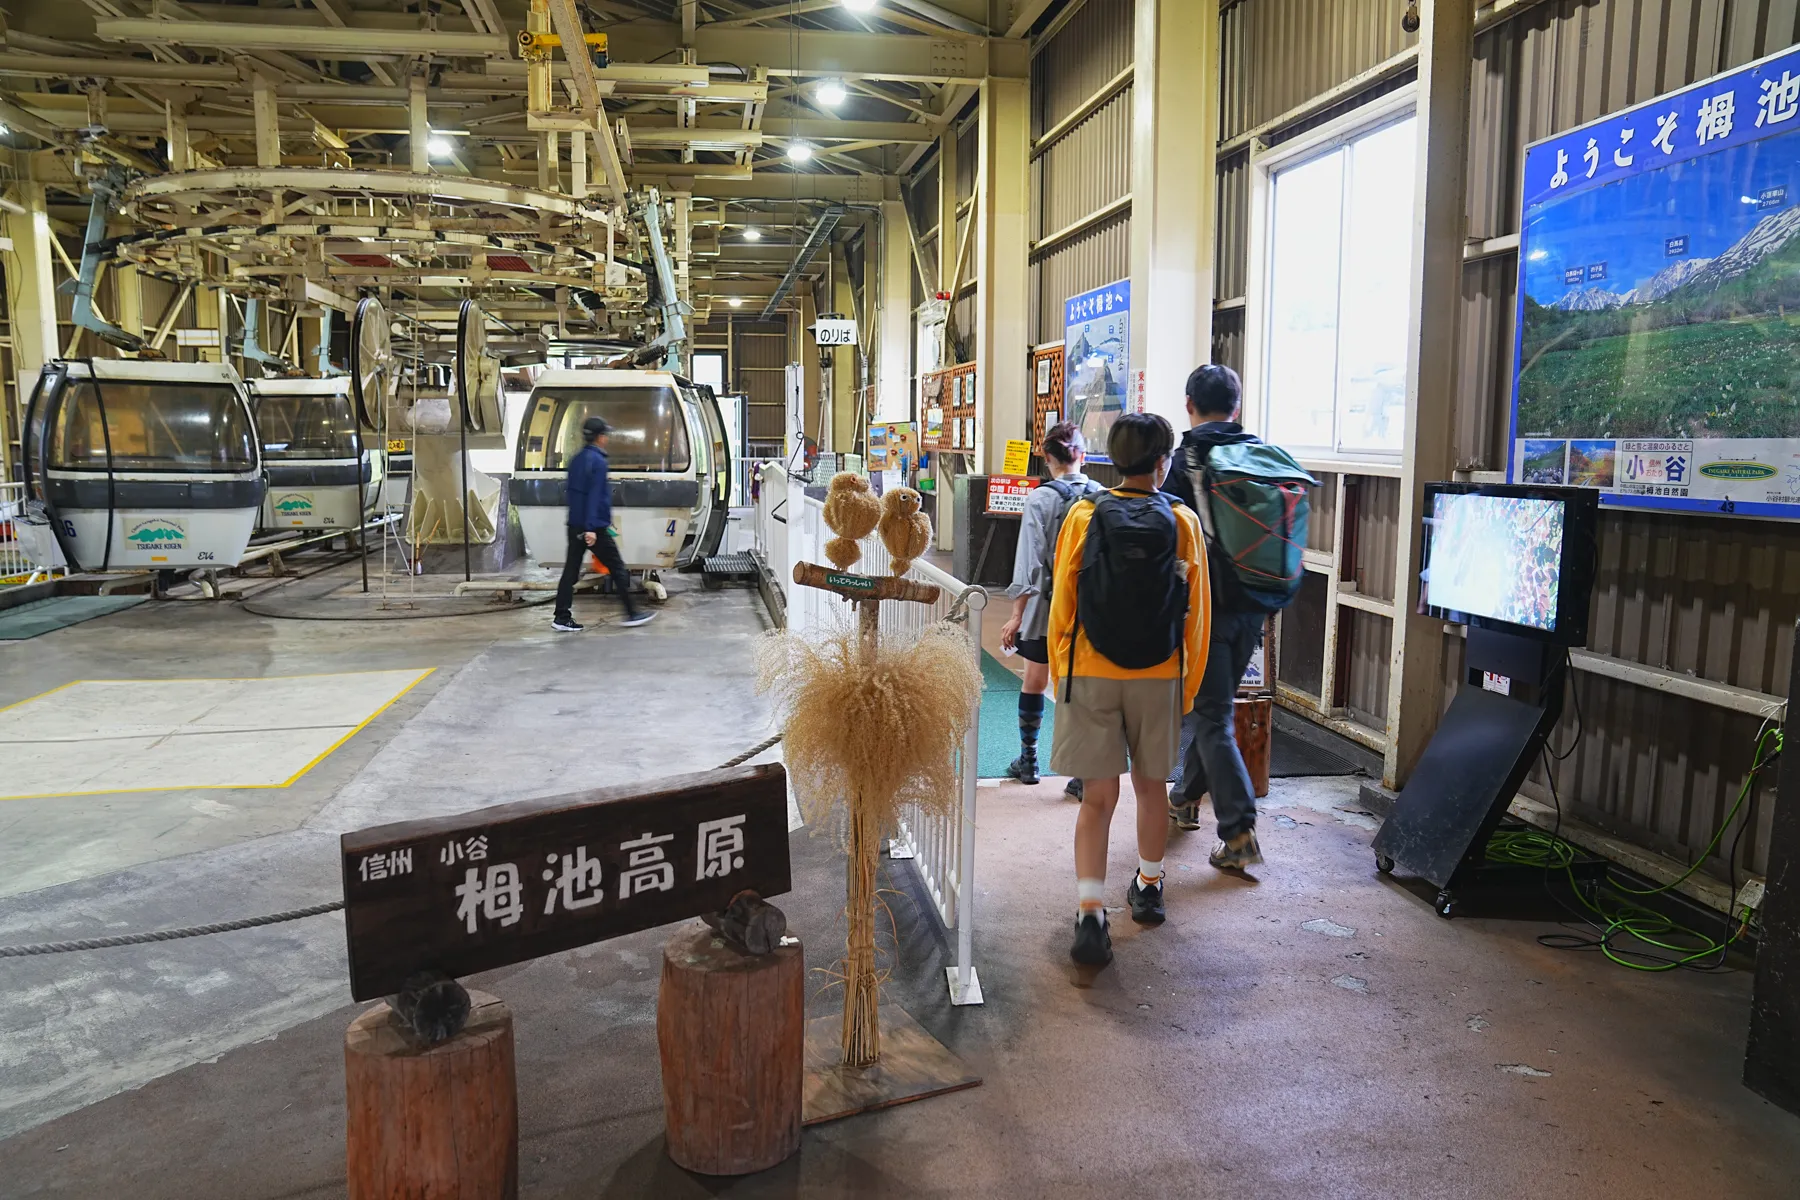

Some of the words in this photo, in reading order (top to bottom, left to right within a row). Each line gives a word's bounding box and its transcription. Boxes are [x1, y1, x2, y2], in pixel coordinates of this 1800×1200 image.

[1070, 290, 1124, 321] ようこそ栂池へ
[820, 329, 851, 342] のりば
[1625, 443, 1689, 451] 緑と雪と温泉のふるさと
[1646, 486, 1689, 497] 栂池自然園
[1719, 501, 1735, 512] 43
[666, 520, 676, 537] 4
[828, 576, 872, 587] いってらっしゃい
[358, 848, 413, 882] 信州
[439, 835, 489, 866] 小谷
[455, 814, 747, 935] 栂池高原
